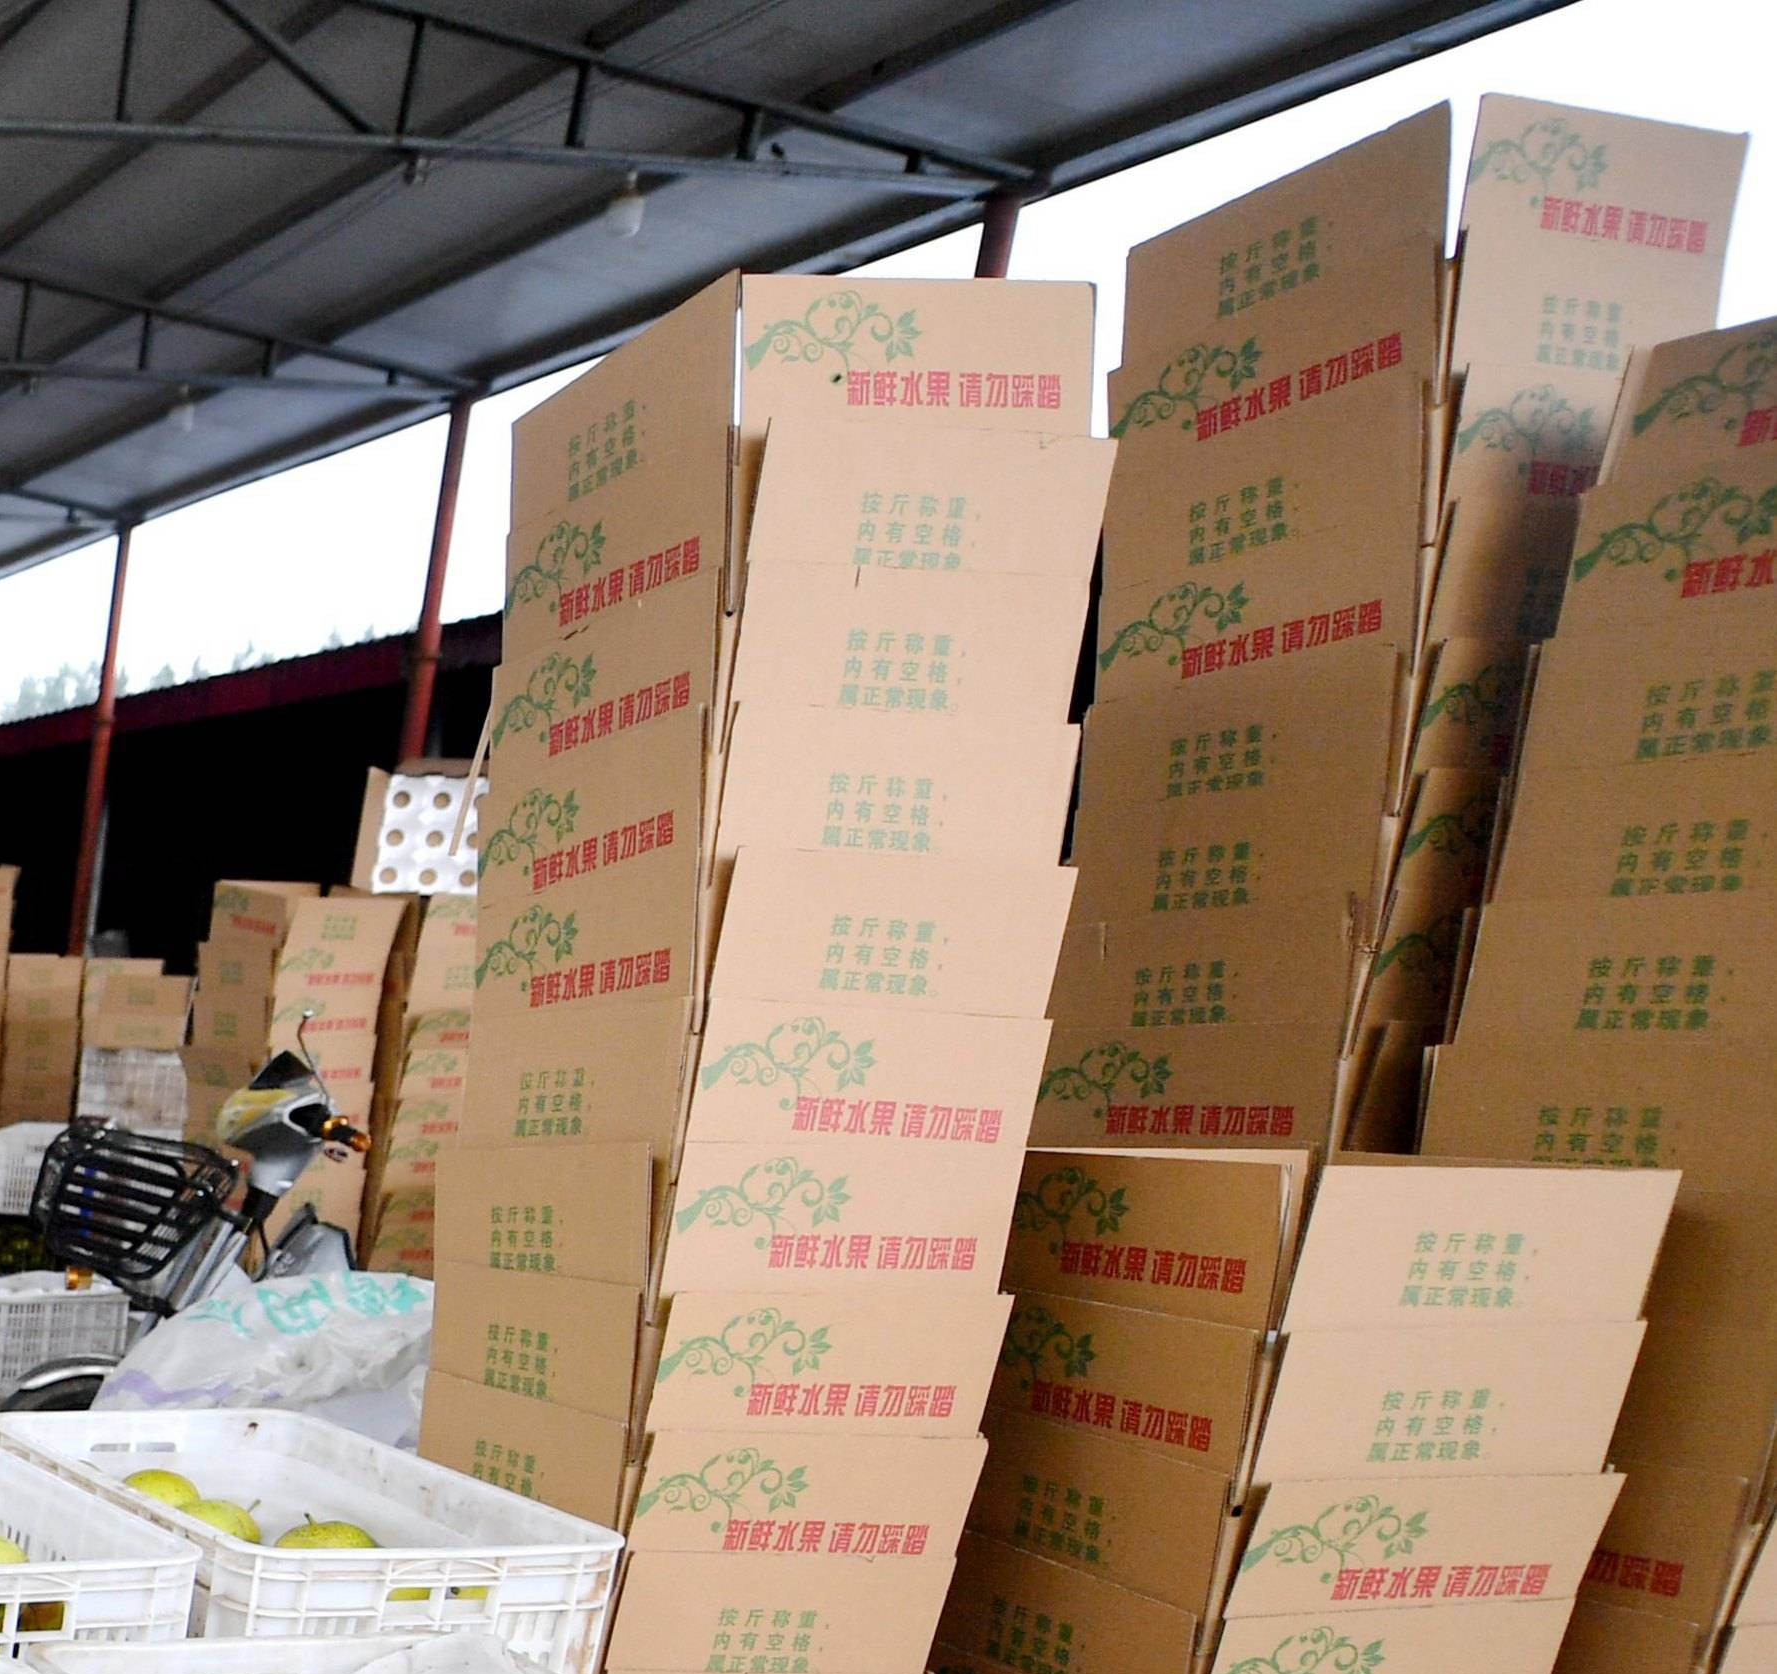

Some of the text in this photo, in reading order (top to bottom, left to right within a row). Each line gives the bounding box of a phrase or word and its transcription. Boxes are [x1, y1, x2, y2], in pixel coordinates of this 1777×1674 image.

[847, 370, 1063, 411] 新鲜水果 请勿踩踏
[1196, 332, 1405, 444] 新鲜水果 请勿踩踏
[558, 536, 703, 629] 新鲜水果 请勿踩踏
[1182, 599, 1385, 680] 新鲜水果 请勿踩踏
[548, 672, 693, 759] 新鲜水果 请勿踩踏
[533, 811, 677, 895] 新鲜水果 请勿踩踏
[530, 948, 673, 1010] 新鲜水果 请勿踩踏
[793, 1097, 1004, 1145] 新鲜水果 请勿踩踏
[1106, 1104, 1297, 1139] 新鲜水果 请勿踩踏
[769, 1233, 980, 1273] 新鲜水果 请勿踩踏
[1060, 1240, 1248, 1297] 新鲜水果 请勿踩踏
[747, 1382, 959, 1421] 新鲜水果 请勿踩踏
[1033, 1382, 1215, 1454] 新鲜水果 请勿踩踏
[723, 1520, 933, 1558] 新鲜水果 请勿踩踏
[1332, 1563, 1552, 1602] 新鲜水果 请勿踩踏
